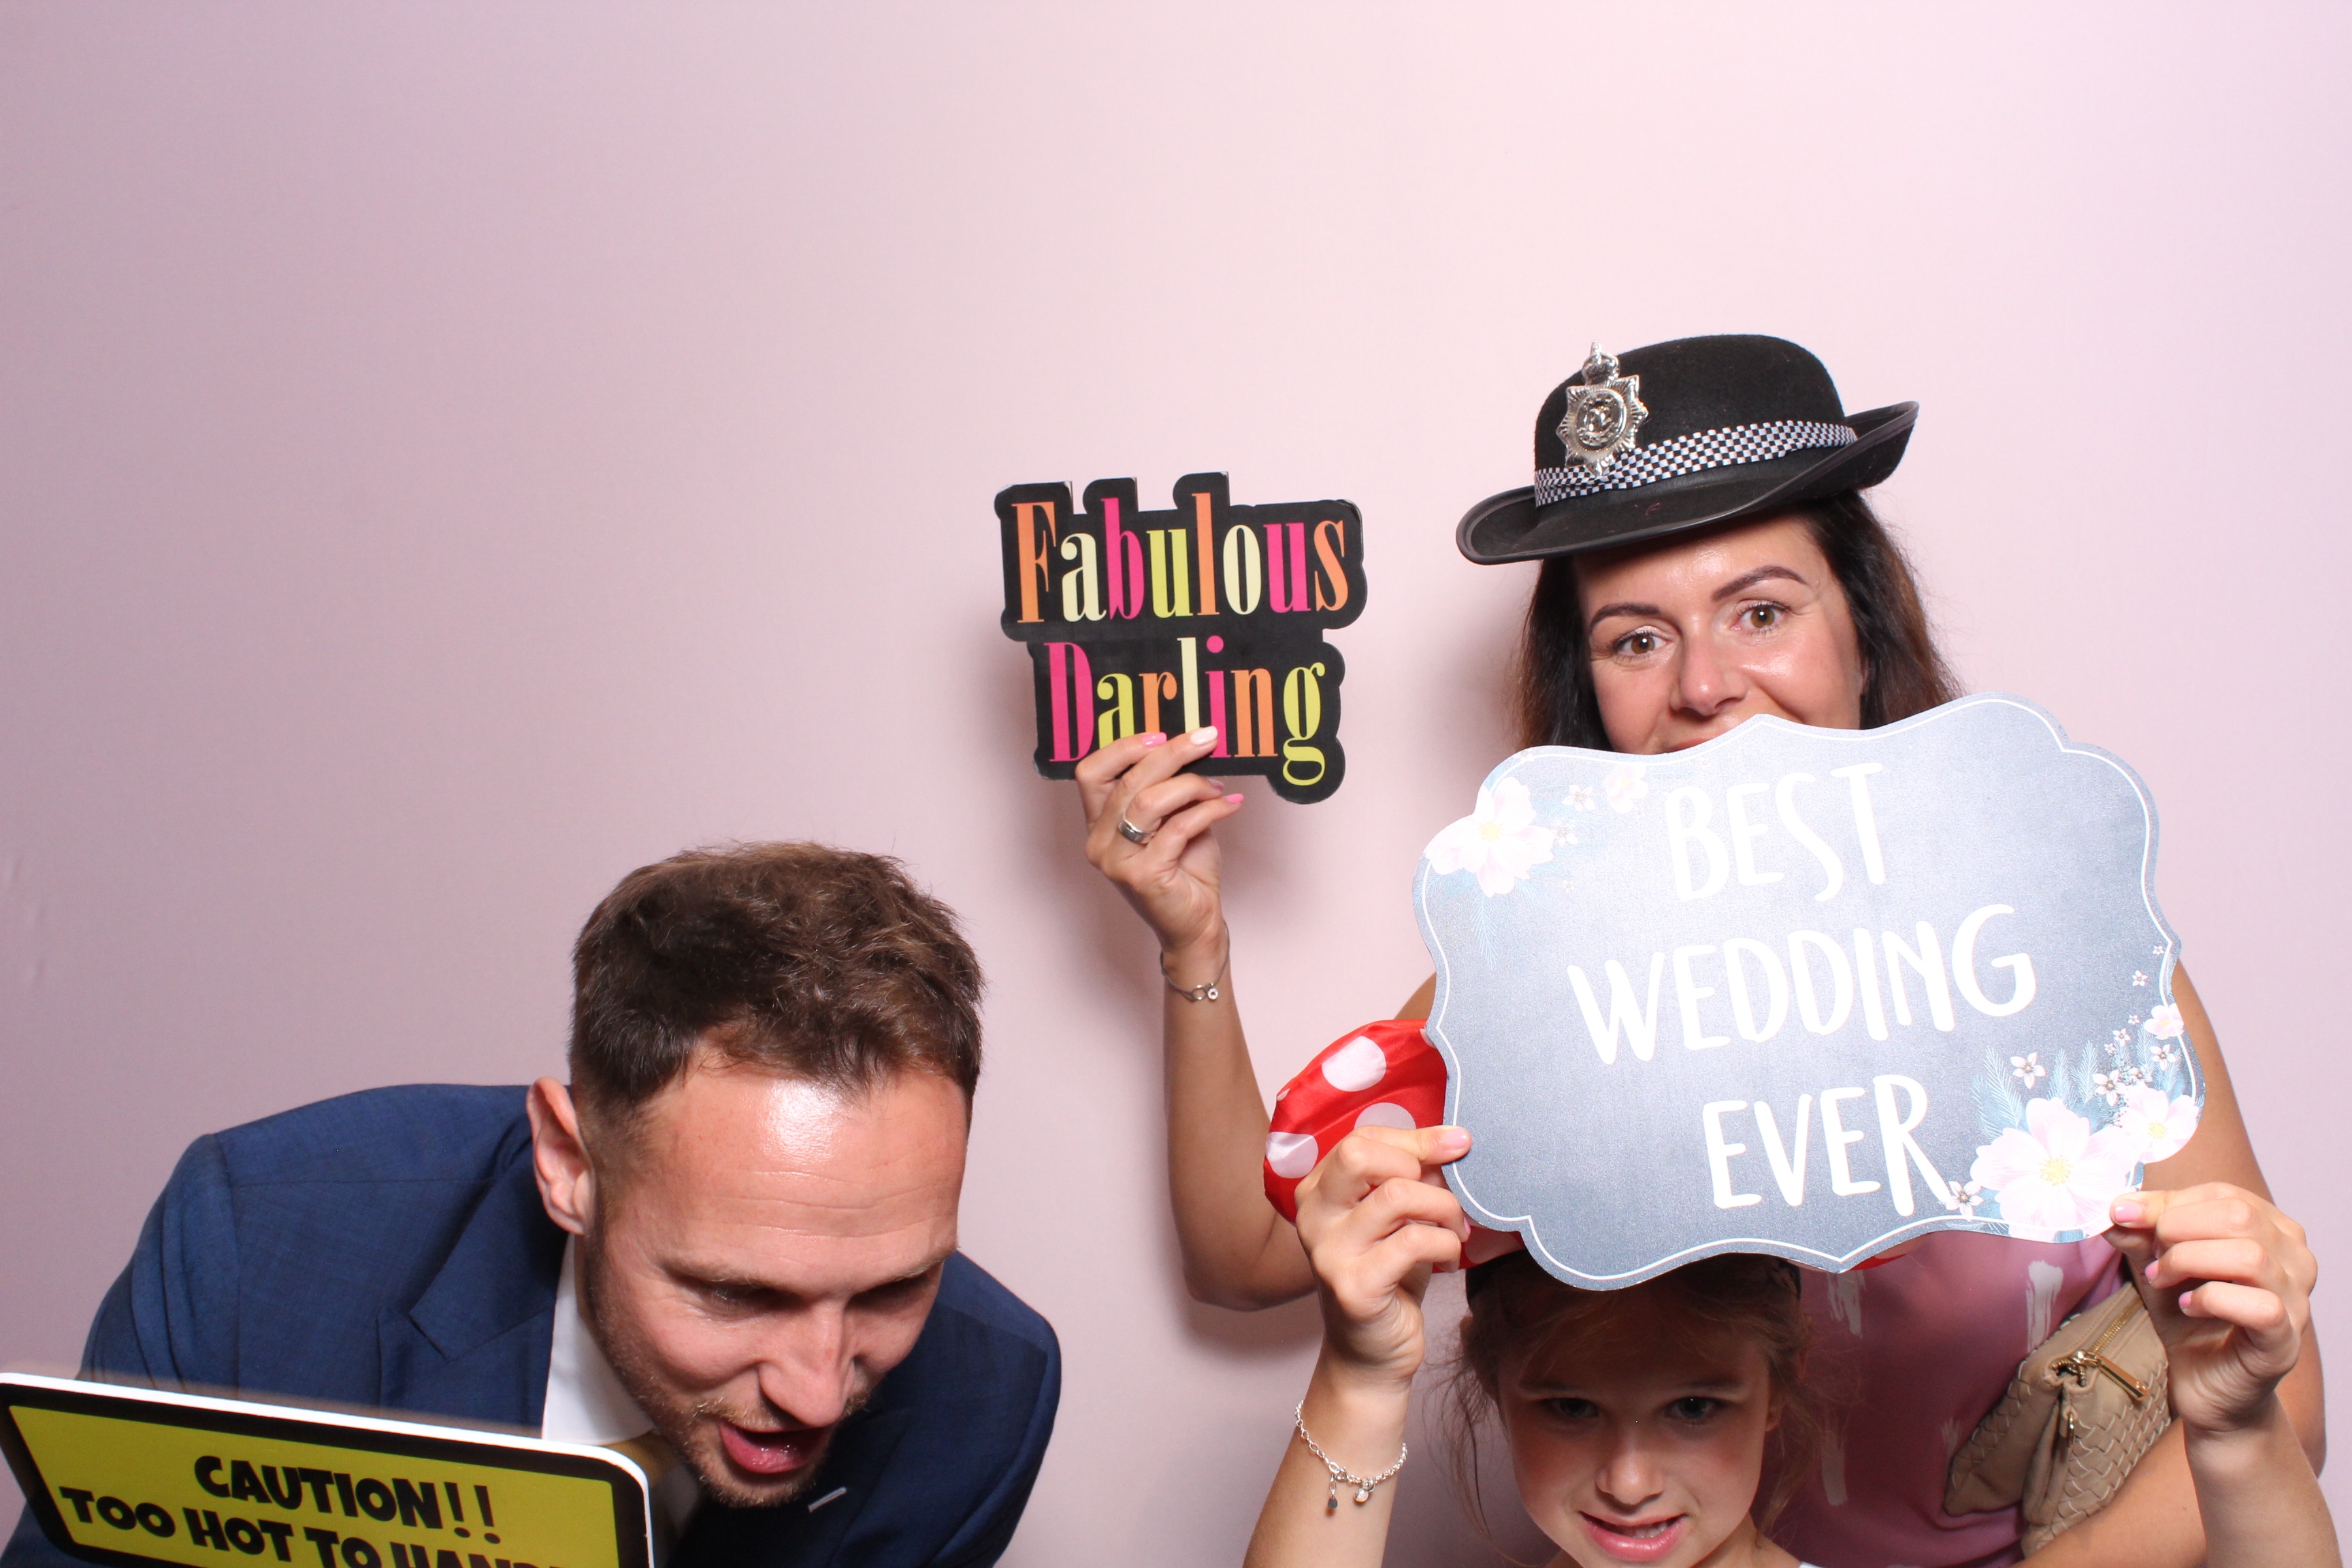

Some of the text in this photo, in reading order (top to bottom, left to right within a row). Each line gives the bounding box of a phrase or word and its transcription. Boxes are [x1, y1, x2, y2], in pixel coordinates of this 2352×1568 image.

[1011, 492, 1349, 623] Fabulous
[1044, 635, 1325, 785] Darling
[1664, 762, 1886, 901] BEST
[1567, 904, 2036, 1065] WEDDING
[1702, 1075, 1951, 1217] EVER
[59, 1486, 176, 1537] TOO
[182, 1507, 294, 1562] HOT
[303, 1526, 382, 1568] TO
[194, 1455, 500, 1544] CAUTION!!
